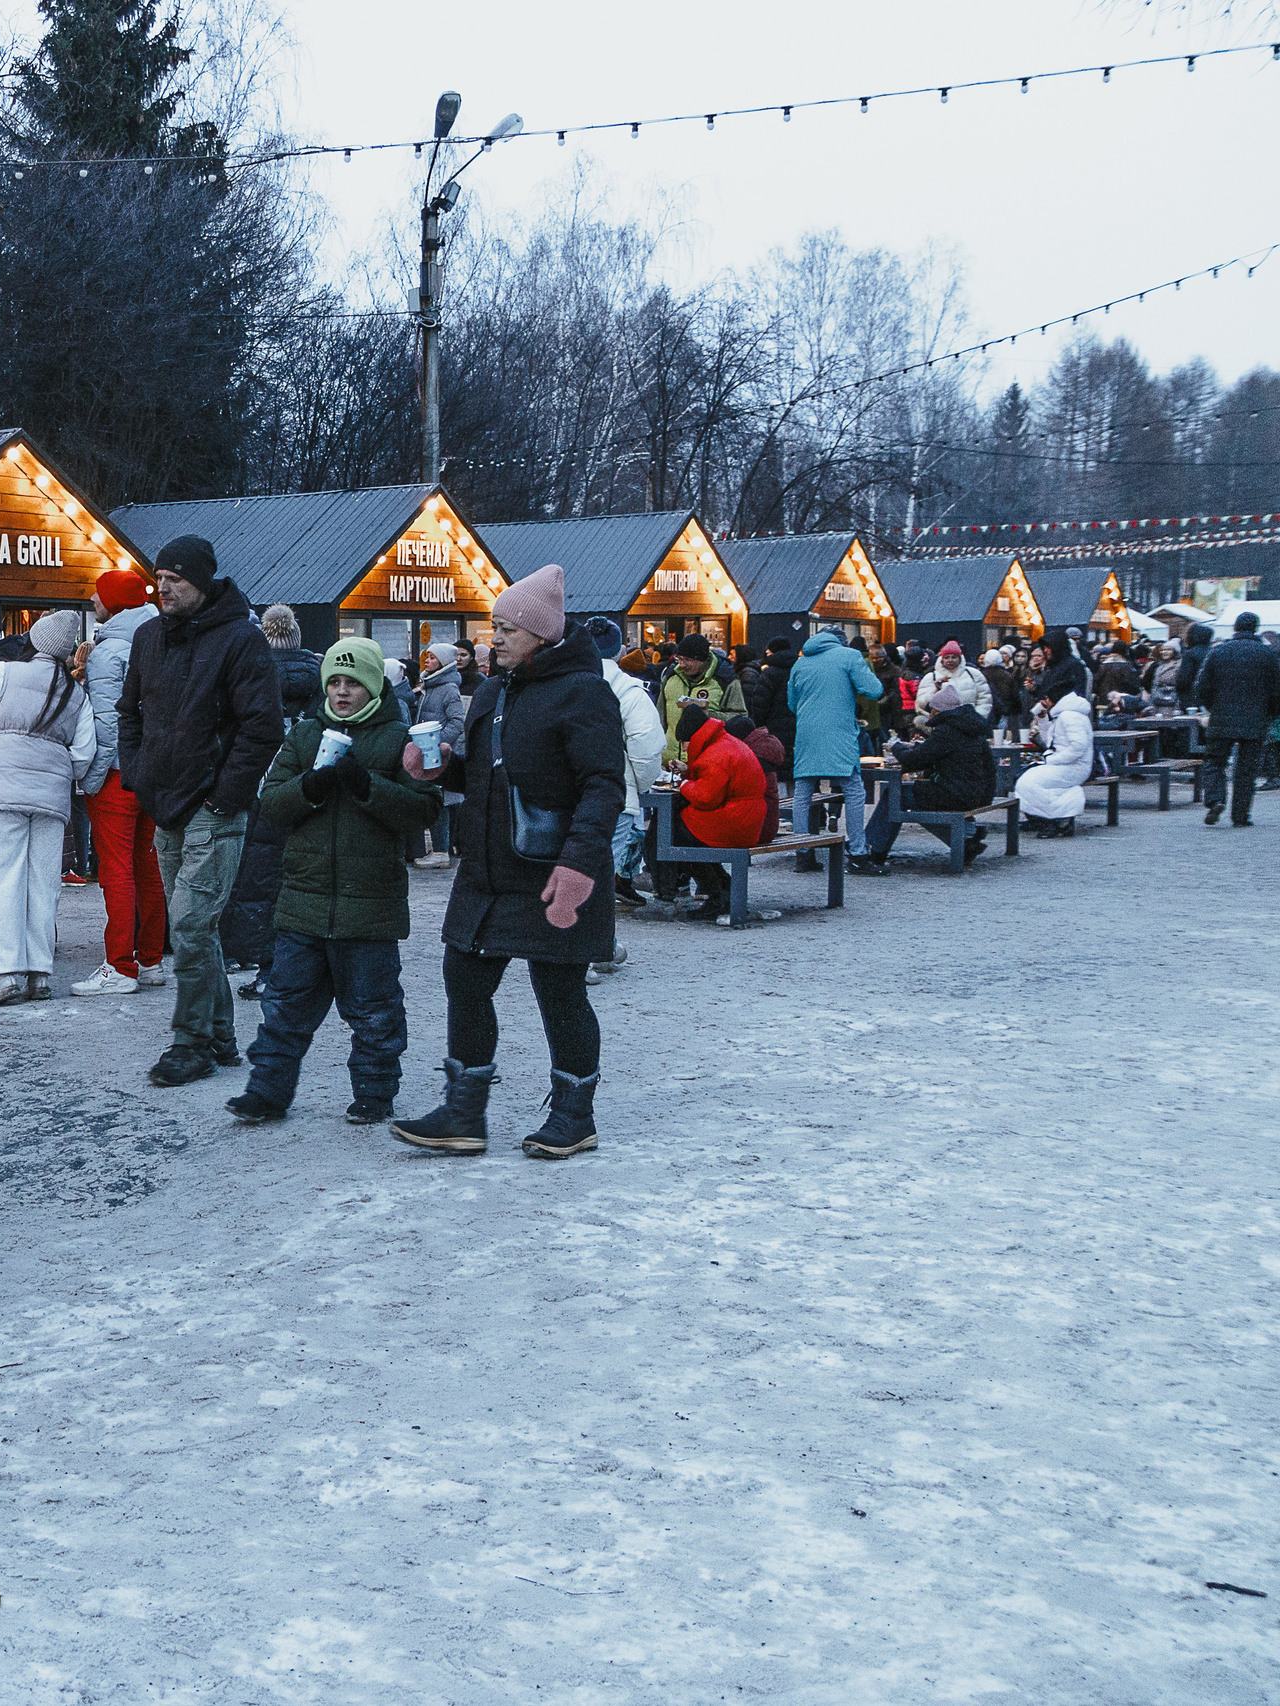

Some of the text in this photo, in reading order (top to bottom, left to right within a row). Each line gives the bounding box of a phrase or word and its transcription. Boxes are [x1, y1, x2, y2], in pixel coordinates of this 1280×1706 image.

[17, 534, 64, 567] GRILL
[396, 535, 450, 568] ПЕЧЁНАЯ
[389, 575, 456, 603] КАРТОШКА
[654, 566, 698, 592] ГЛИНТВЕЙН
[334, 661, 356, 669] adidas
